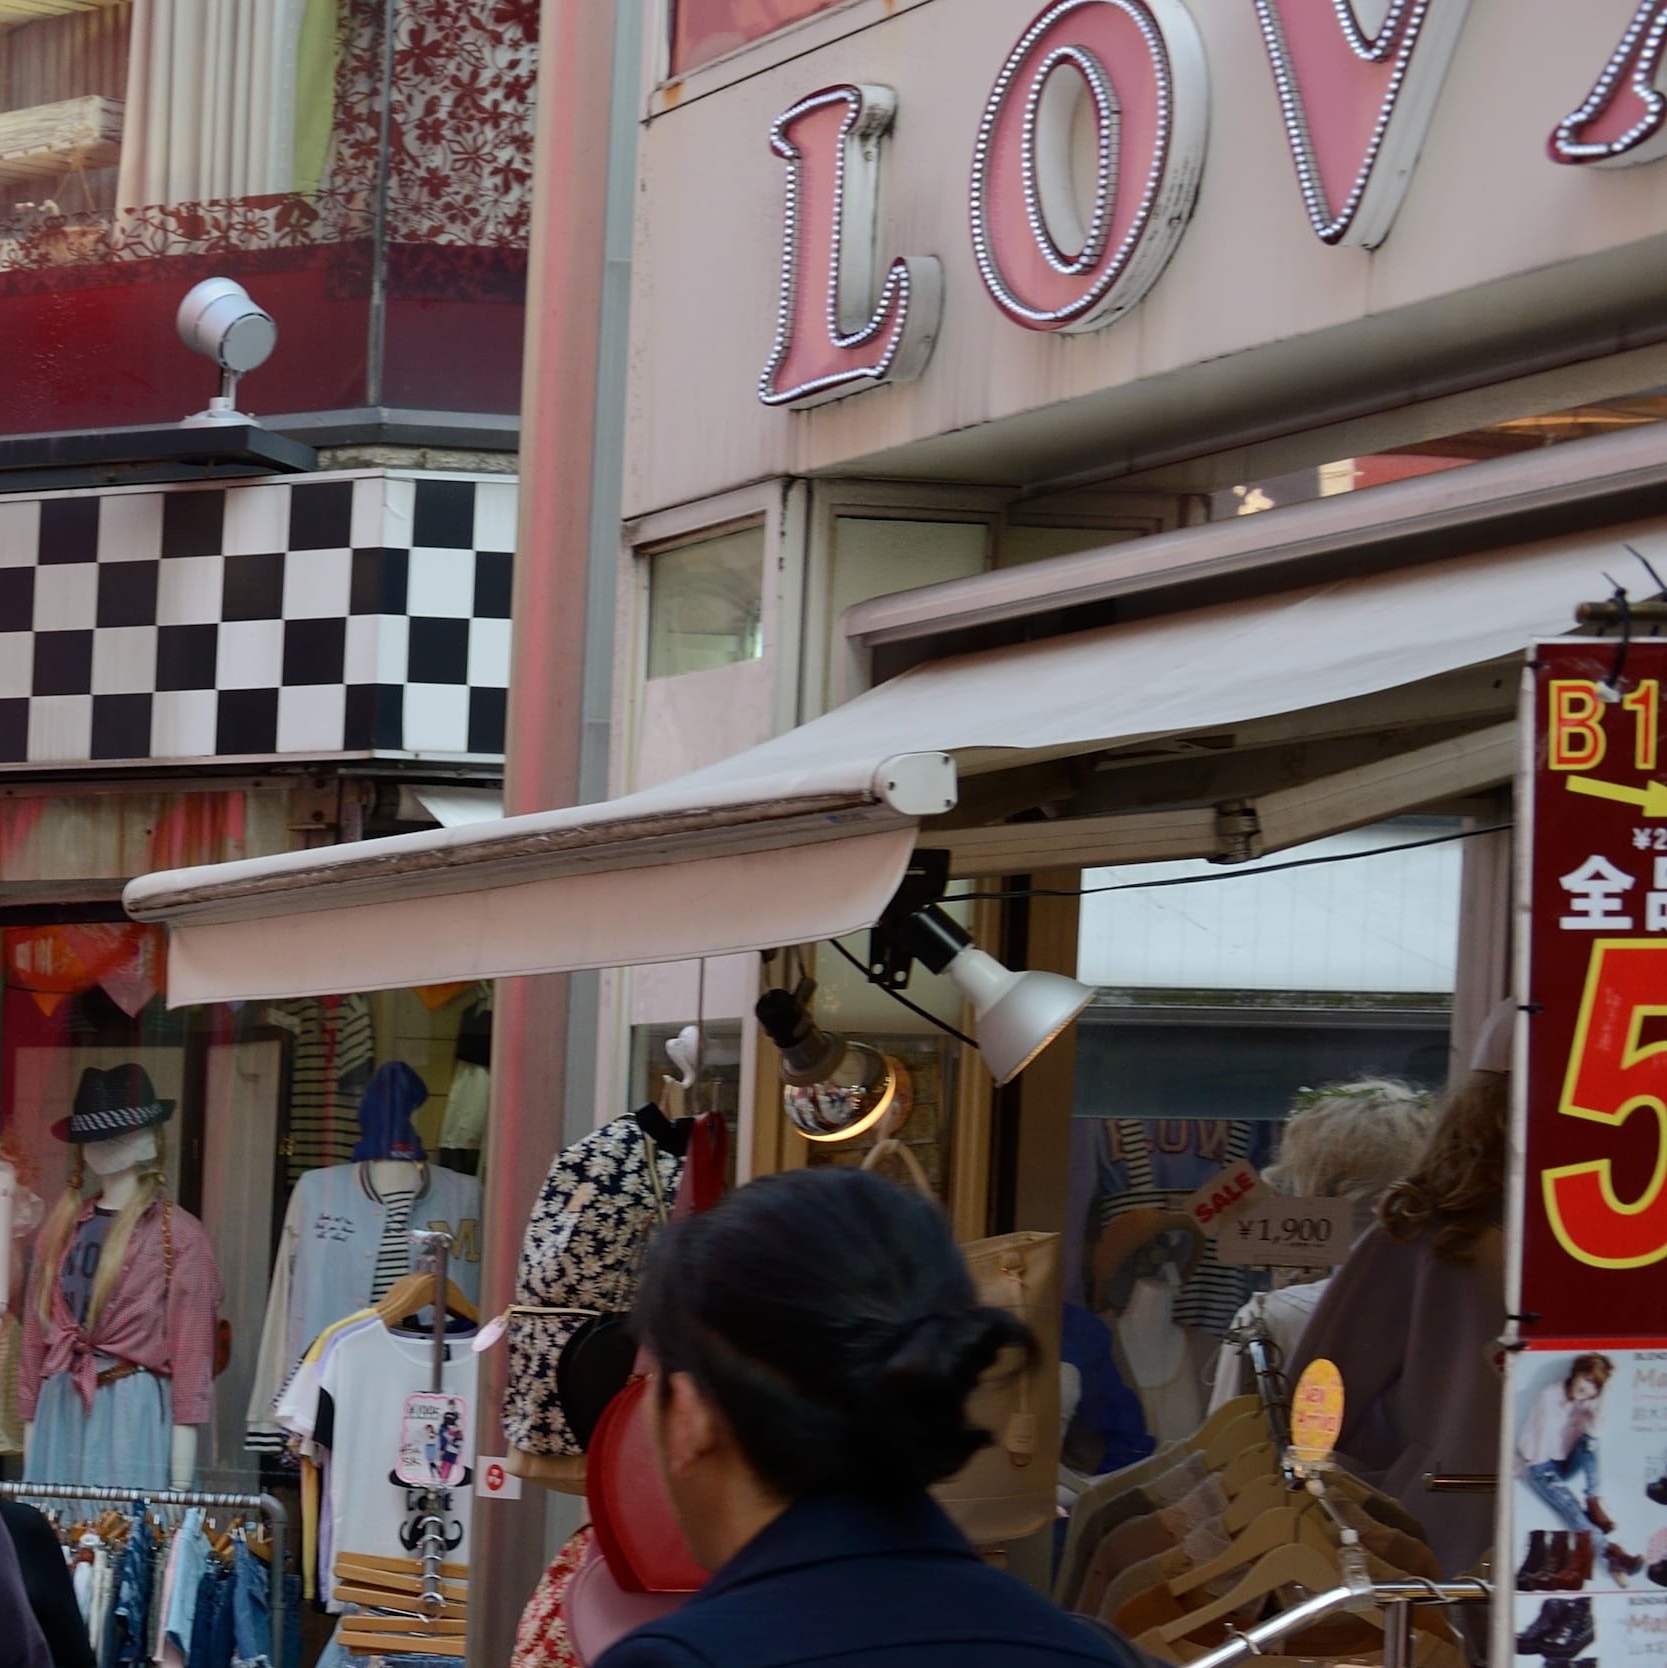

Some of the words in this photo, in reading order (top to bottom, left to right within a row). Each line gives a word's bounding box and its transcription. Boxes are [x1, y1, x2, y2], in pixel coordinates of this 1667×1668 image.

[1548, 679, 1659, 771] B1
[1194, 1172, 1256, 1224] SALE
[1236, 1217, 1333, 1244] ¥1,900
